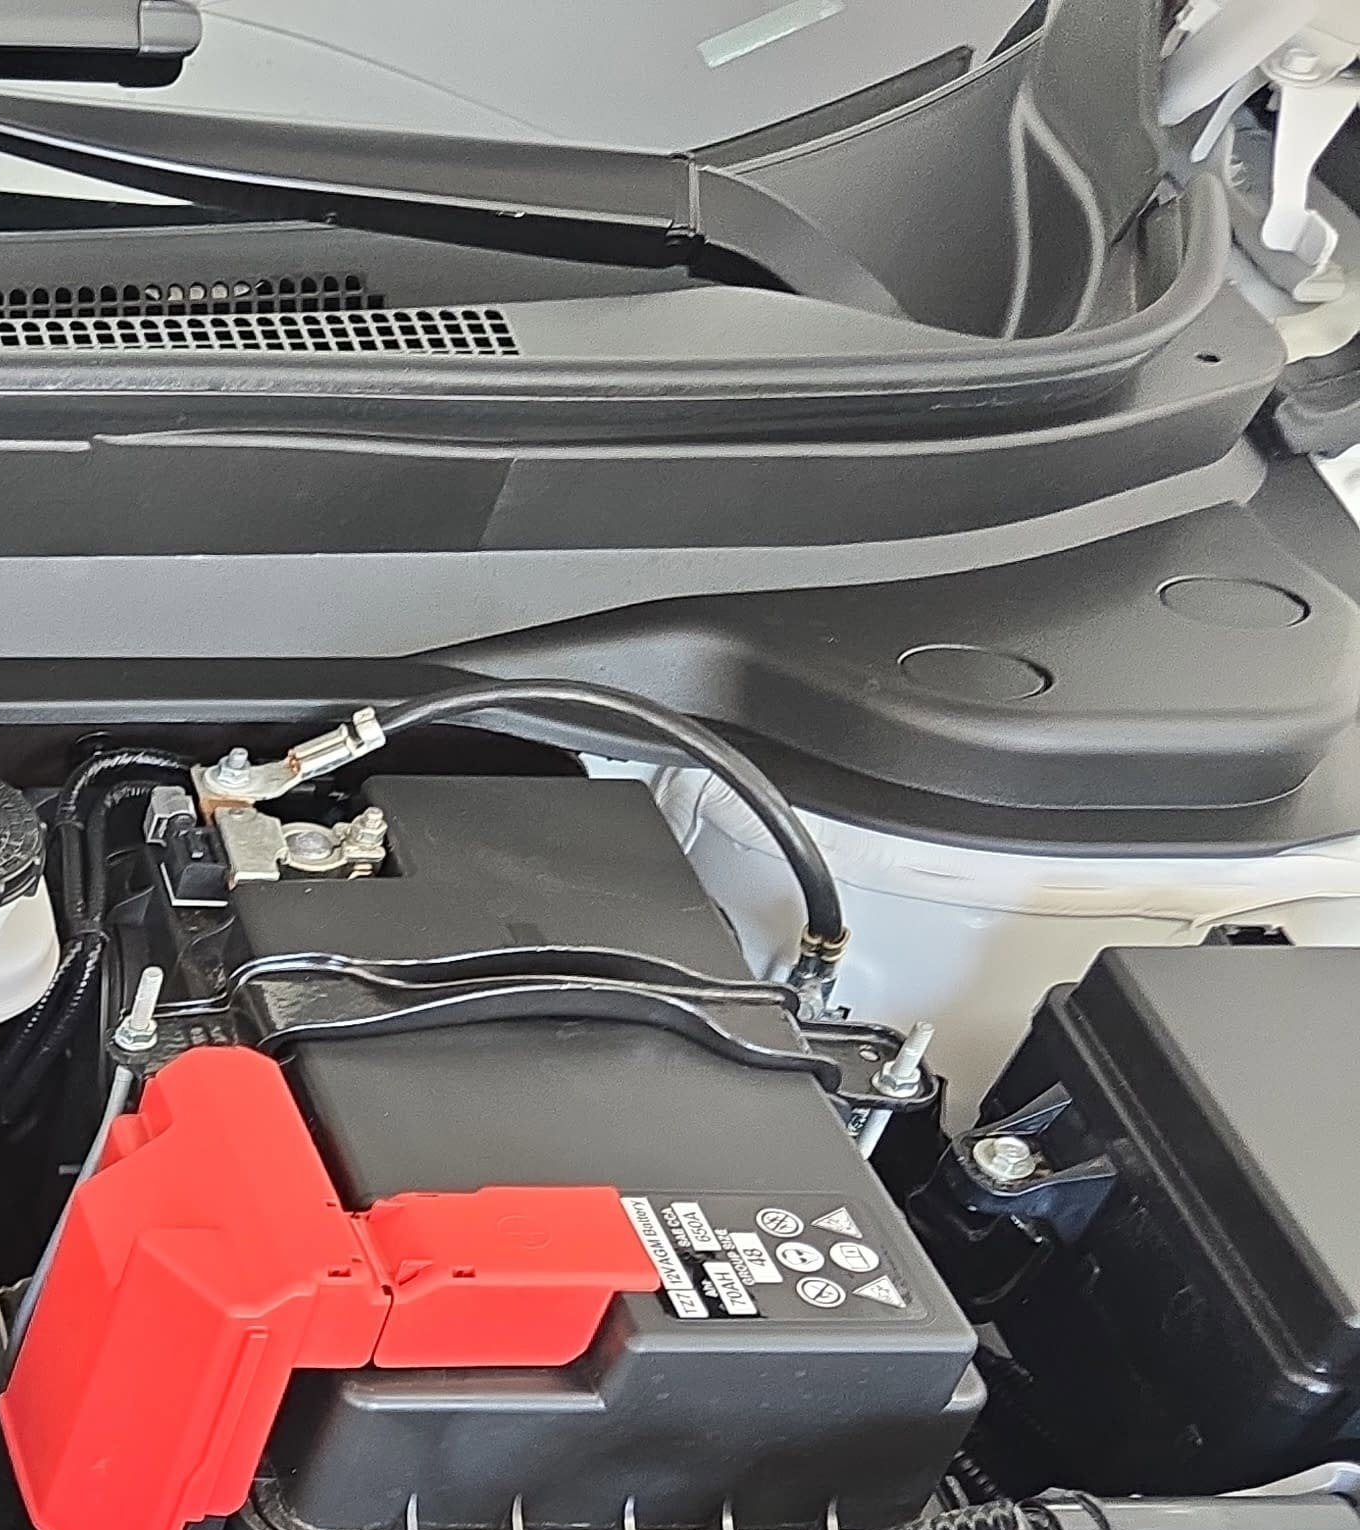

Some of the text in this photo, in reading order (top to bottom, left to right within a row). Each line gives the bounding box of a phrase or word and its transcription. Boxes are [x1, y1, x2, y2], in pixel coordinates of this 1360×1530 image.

[631, 1199, 657, 1236] Battery
[683, 1211, 711, 1243] 650A
[727, 1250, 756, 1286] GROUP
[742, 1248, 767, 1267] 48
[714, 1272, 746, 1306] 70AH
